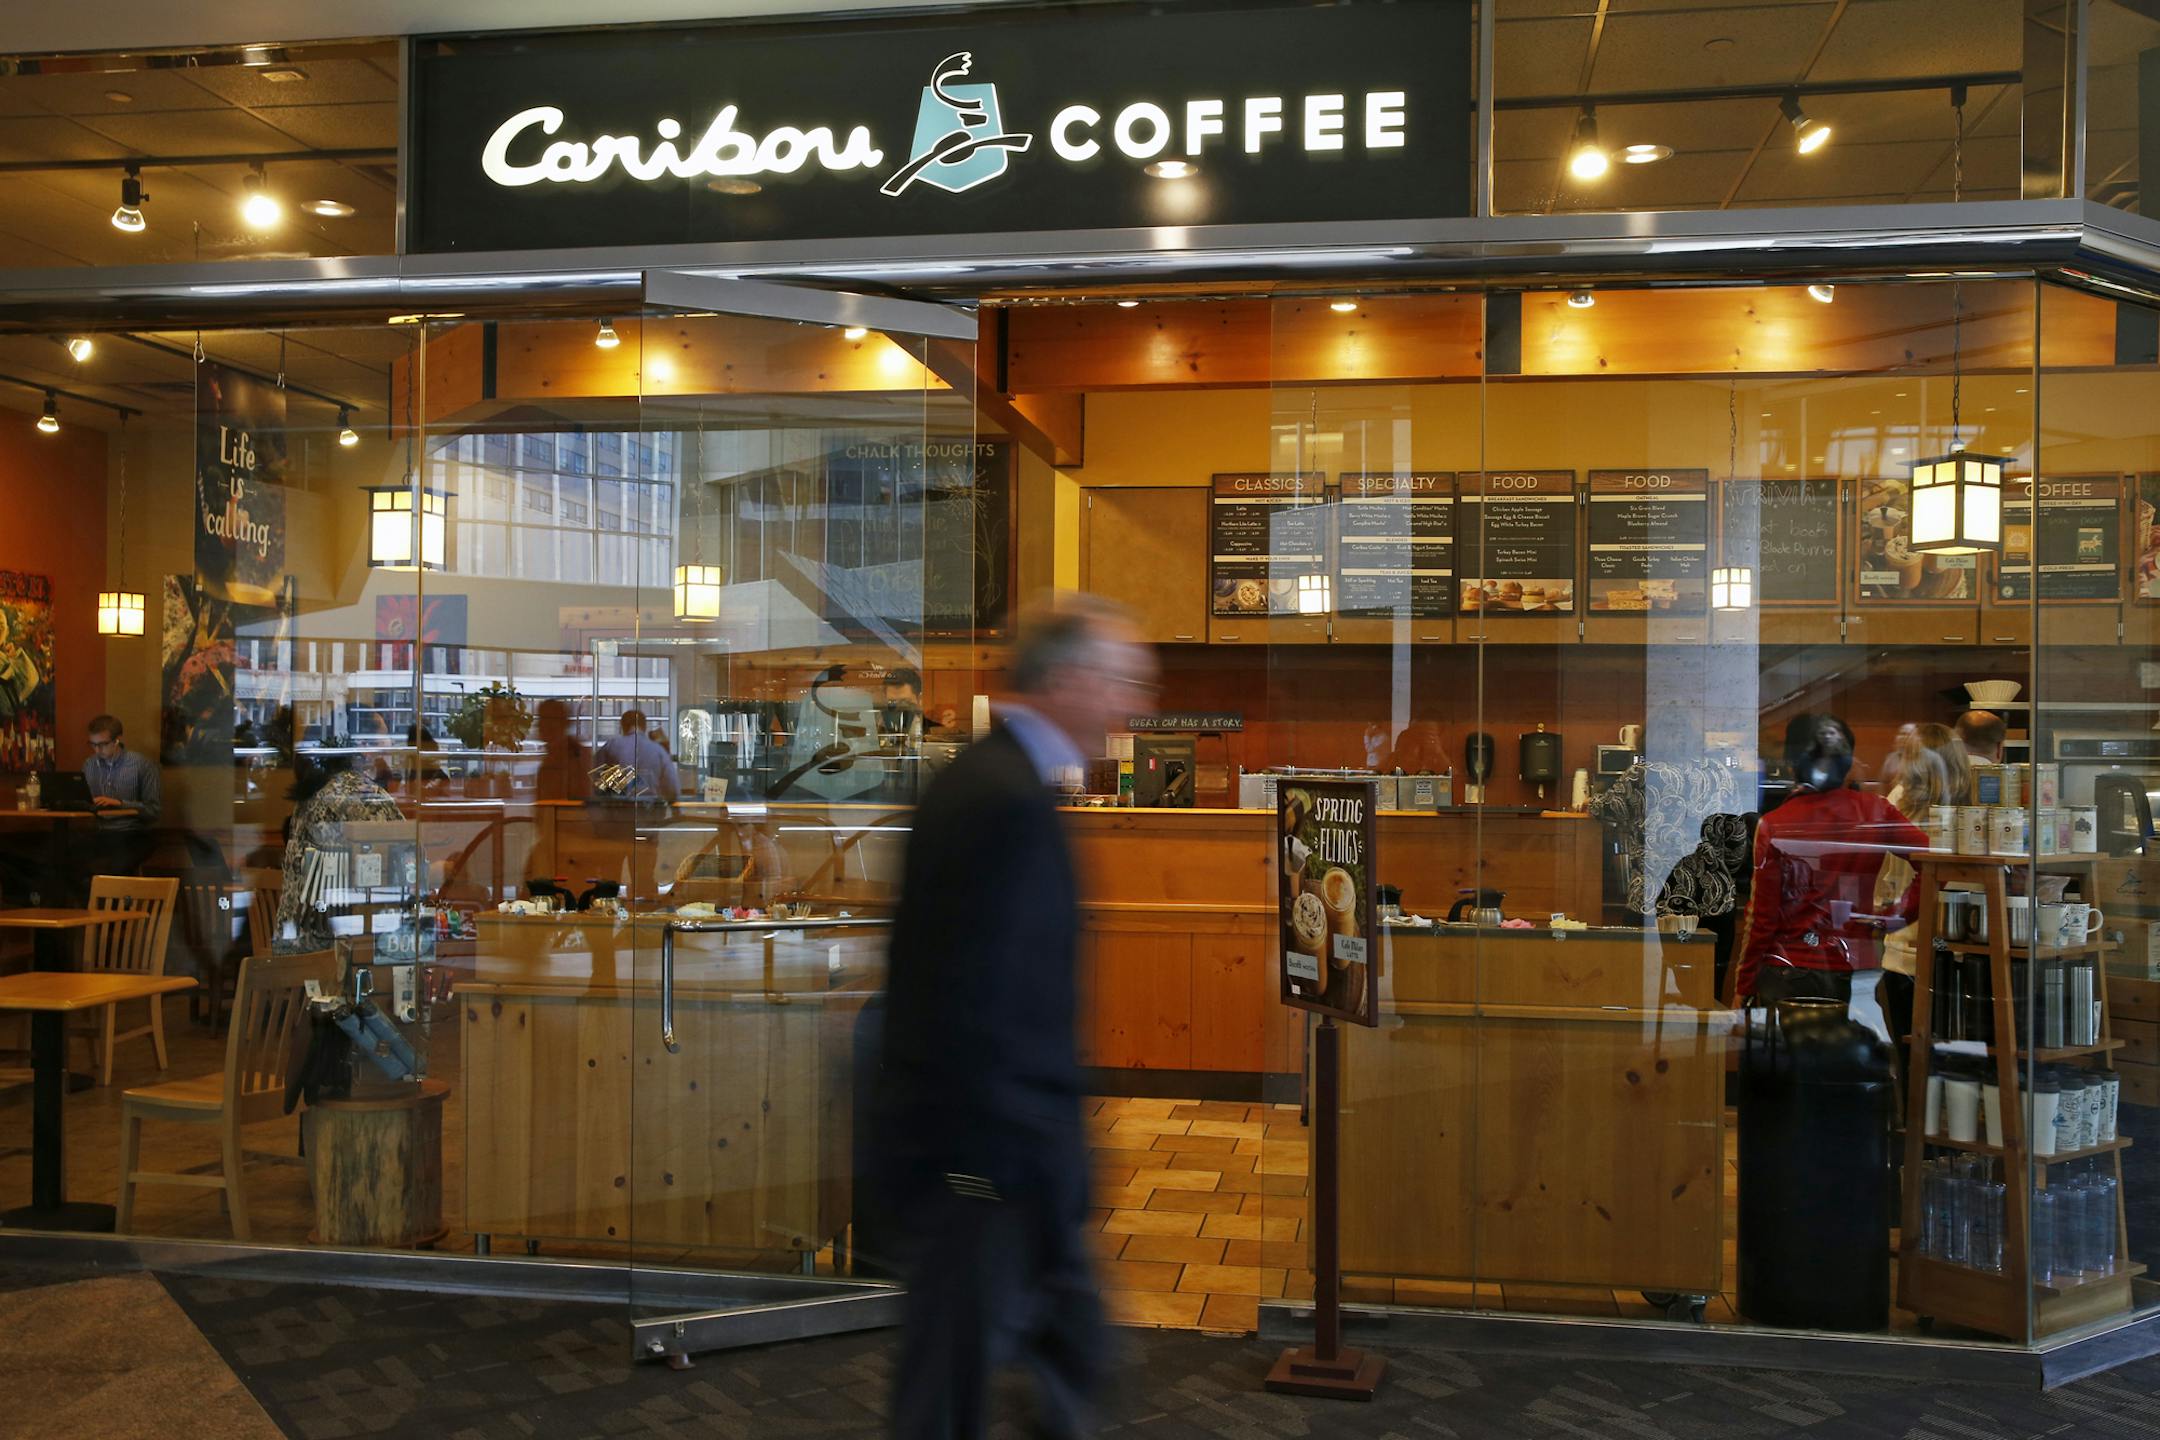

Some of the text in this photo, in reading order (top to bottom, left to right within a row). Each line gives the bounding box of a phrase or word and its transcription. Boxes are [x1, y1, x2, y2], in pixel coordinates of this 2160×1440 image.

[481, 91, 1407, 188] Caribou COFFEE
[219, 425, 256, 472] Life
[846, 444, 995, 458] CHALK THOUGHTS
[230, 469, 244, 500] is
[1234, 478, 1304, 492] CLASSICS
[1357, 477, 1436, 491] SPECIALTY
[1492, 476, 1538, 489] FOOD
[1625, 475, 1671, 489] FOOD
[2024, 483, 2092, 497] COFFEE
[207, 501, 271, 558] calling.
[1129, 717, 1243, 728] EVERY CUP HAS A STORY.
[1314, 797, 1363, 825] SPRING
[1319, 827, 1359, 865] FLINGS
